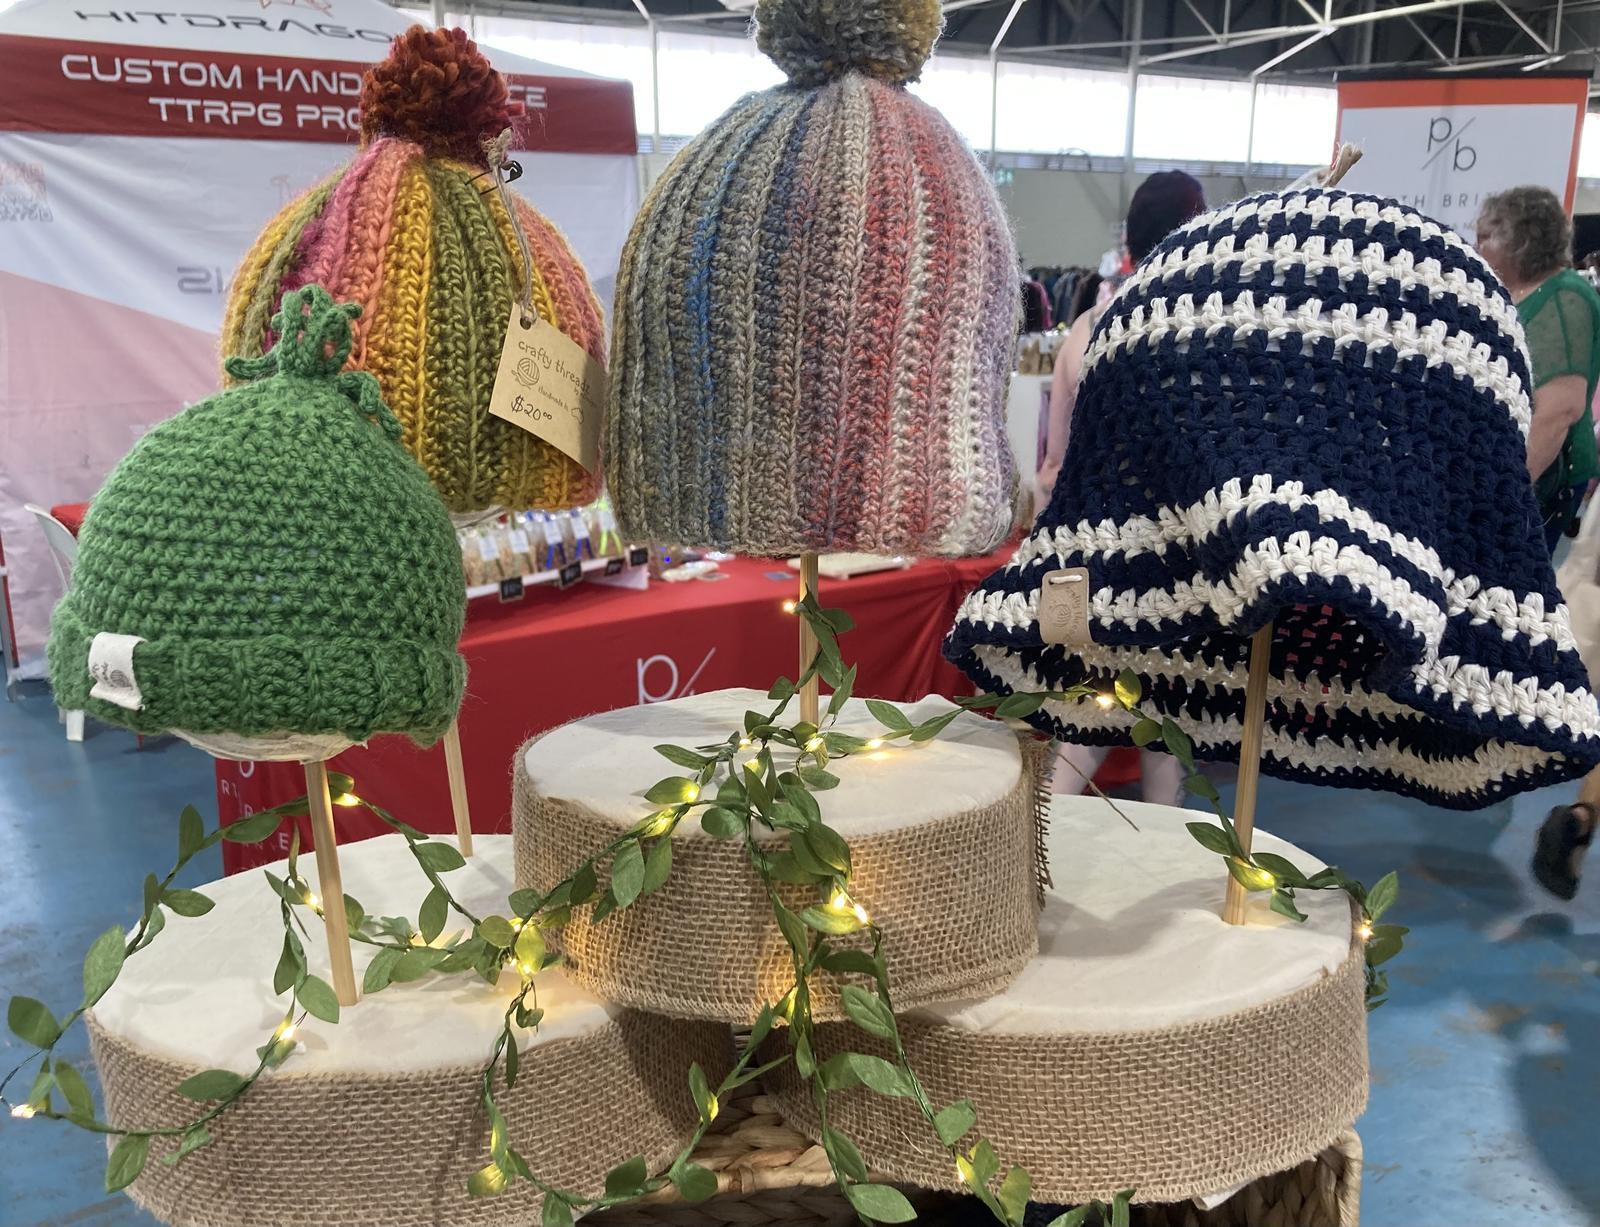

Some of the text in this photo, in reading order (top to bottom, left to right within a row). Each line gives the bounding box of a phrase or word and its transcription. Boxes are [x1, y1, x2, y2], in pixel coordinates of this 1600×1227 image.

[74, 10, 393, 43] HITDRAGO
[61, 54, 242, 90] CUSTOM
[256, 66, 363, 96] HAND
[148, 96, 362, 131] TTRPG PRO
[518, 341, 552, 369] crafty
